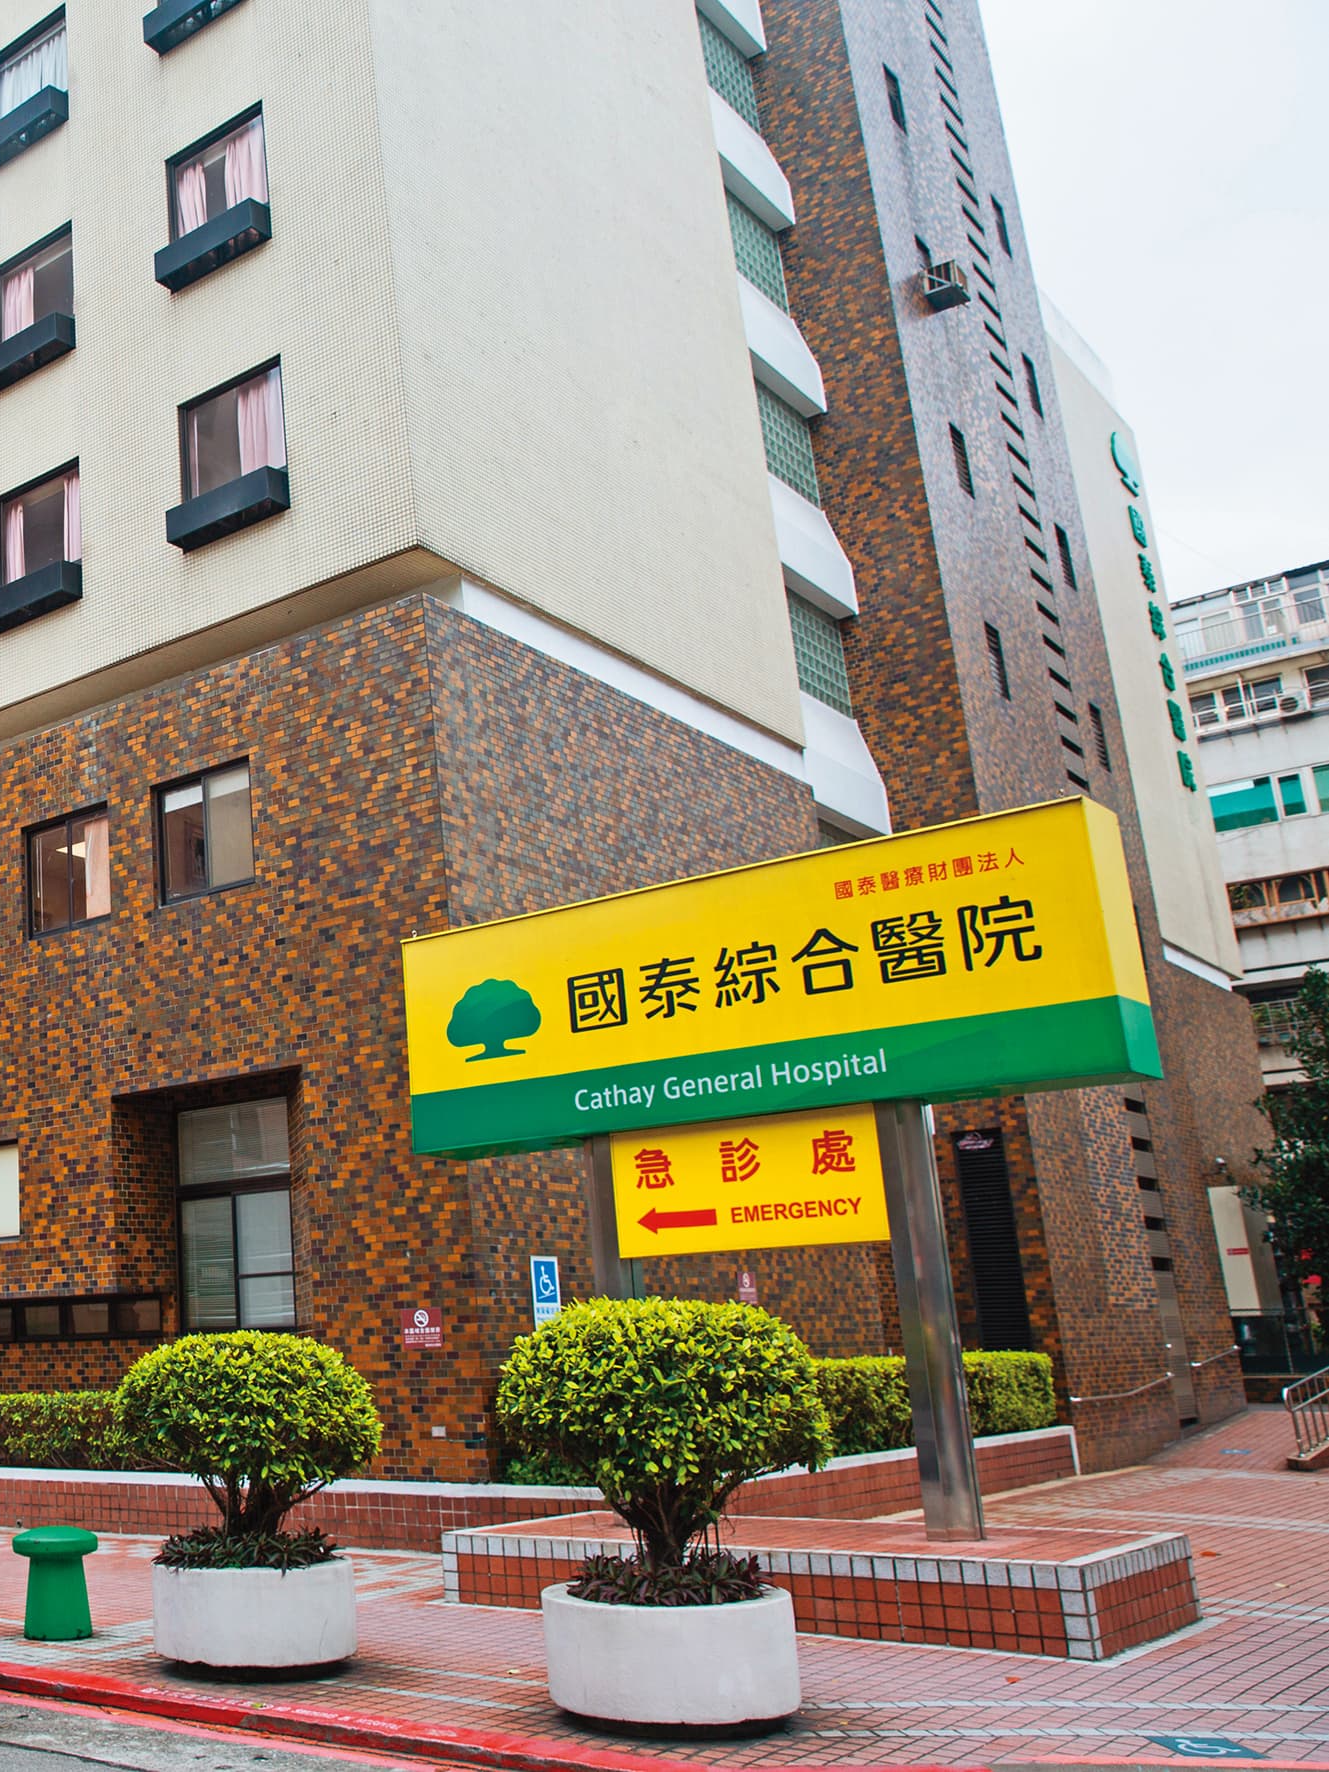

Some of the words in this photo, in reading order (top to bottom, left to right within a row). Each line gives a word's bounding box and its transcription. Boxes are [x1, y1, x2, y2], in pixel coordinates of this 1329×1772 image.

[834, 847, 1025, 900] 國泰醫療財團法人
[566, 895, 1043, 1033] 國泰綜合醫院
[574, 1083, 656, 1111] Cathay
[663, 1065, 762, 1100] General
[771, 1048, 887, 1086] Hospital
[633, 1129, 856, 1190] 急診處
[730, 1197, 862, 1224] EMERGENCY
